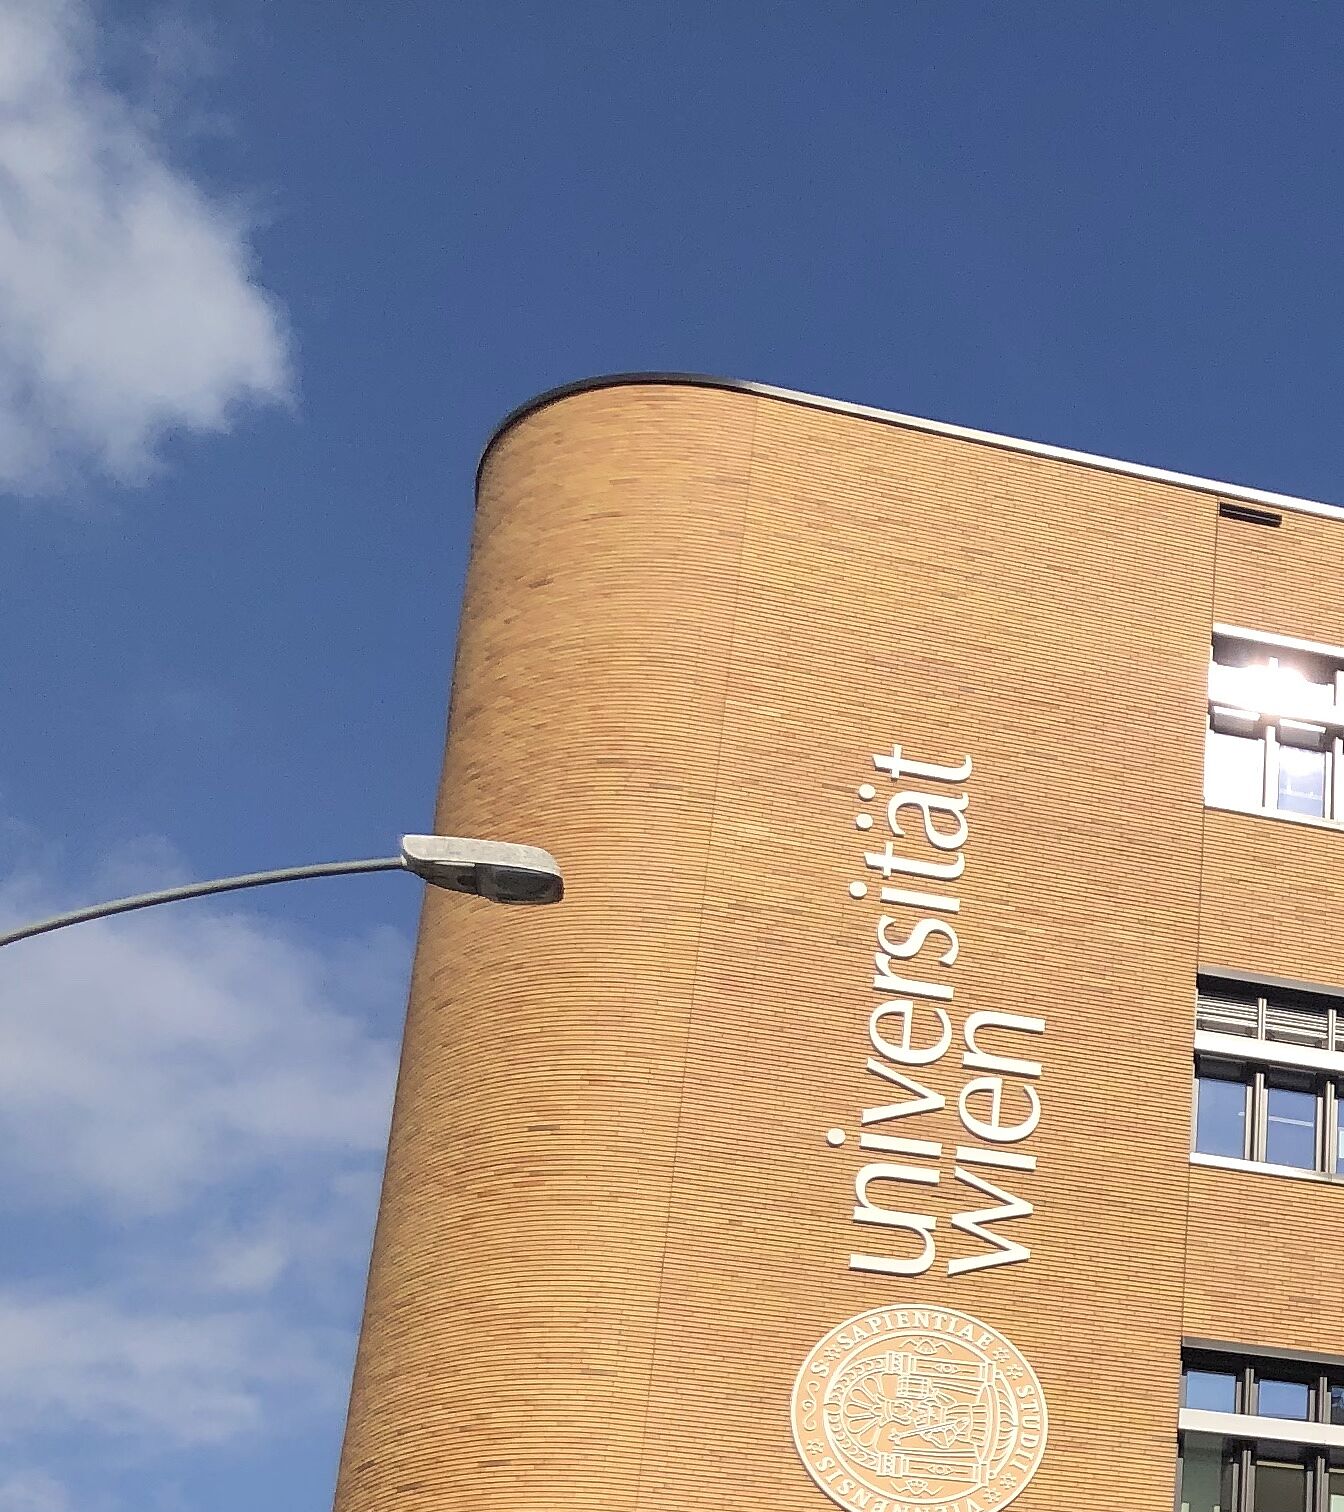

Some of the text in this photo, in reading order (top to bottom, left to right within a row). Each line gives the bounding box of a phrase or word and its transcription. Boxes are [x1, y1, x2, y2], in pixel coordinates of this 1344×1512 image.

[826, 744, 973, 1277] universität
[948, 1010, 1046, 1276] wien
[836, 1311, 994, 1349] SAPIENTIAE
[1010, 1384, 1041, 1473] STUDII
